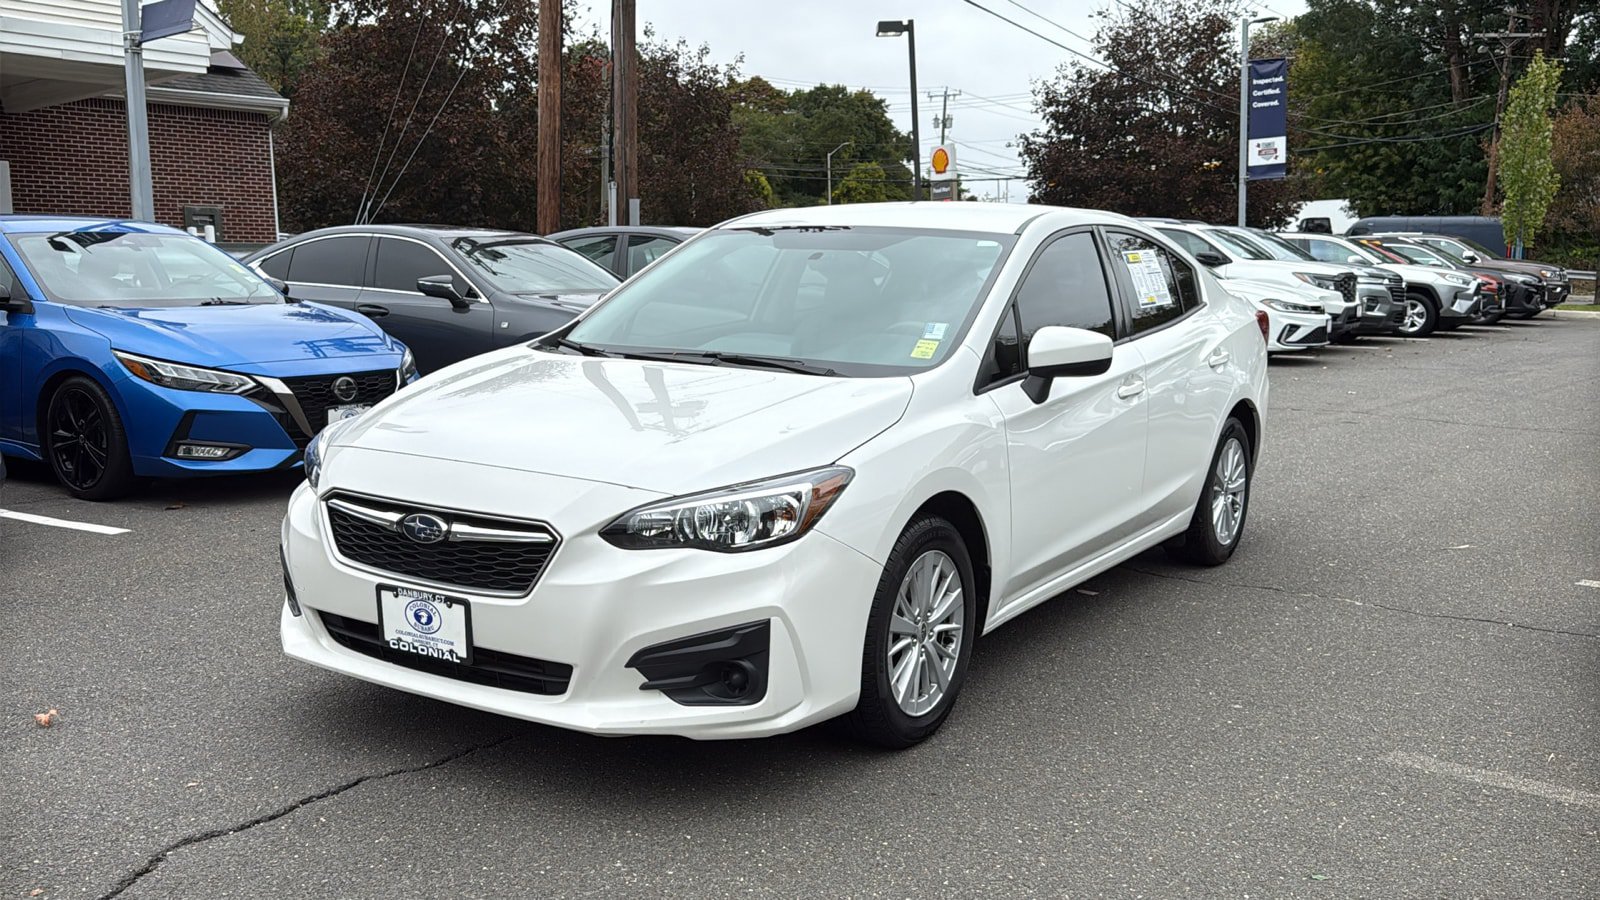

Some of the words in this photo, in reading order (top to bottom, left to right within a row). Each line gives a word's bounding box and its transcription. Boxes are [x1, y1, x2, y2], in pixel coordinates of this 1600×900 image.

[1252, 76, 1284, 85] Inspected.
[1252, 88, 1281, 97] Certified.
[1252, 99, 1279, 108] Covered.
[435, 596, 446, 604] CT
[409, 601, 437, 617] COLONIAL
[389, 639, 460, 663] COLONIAL
